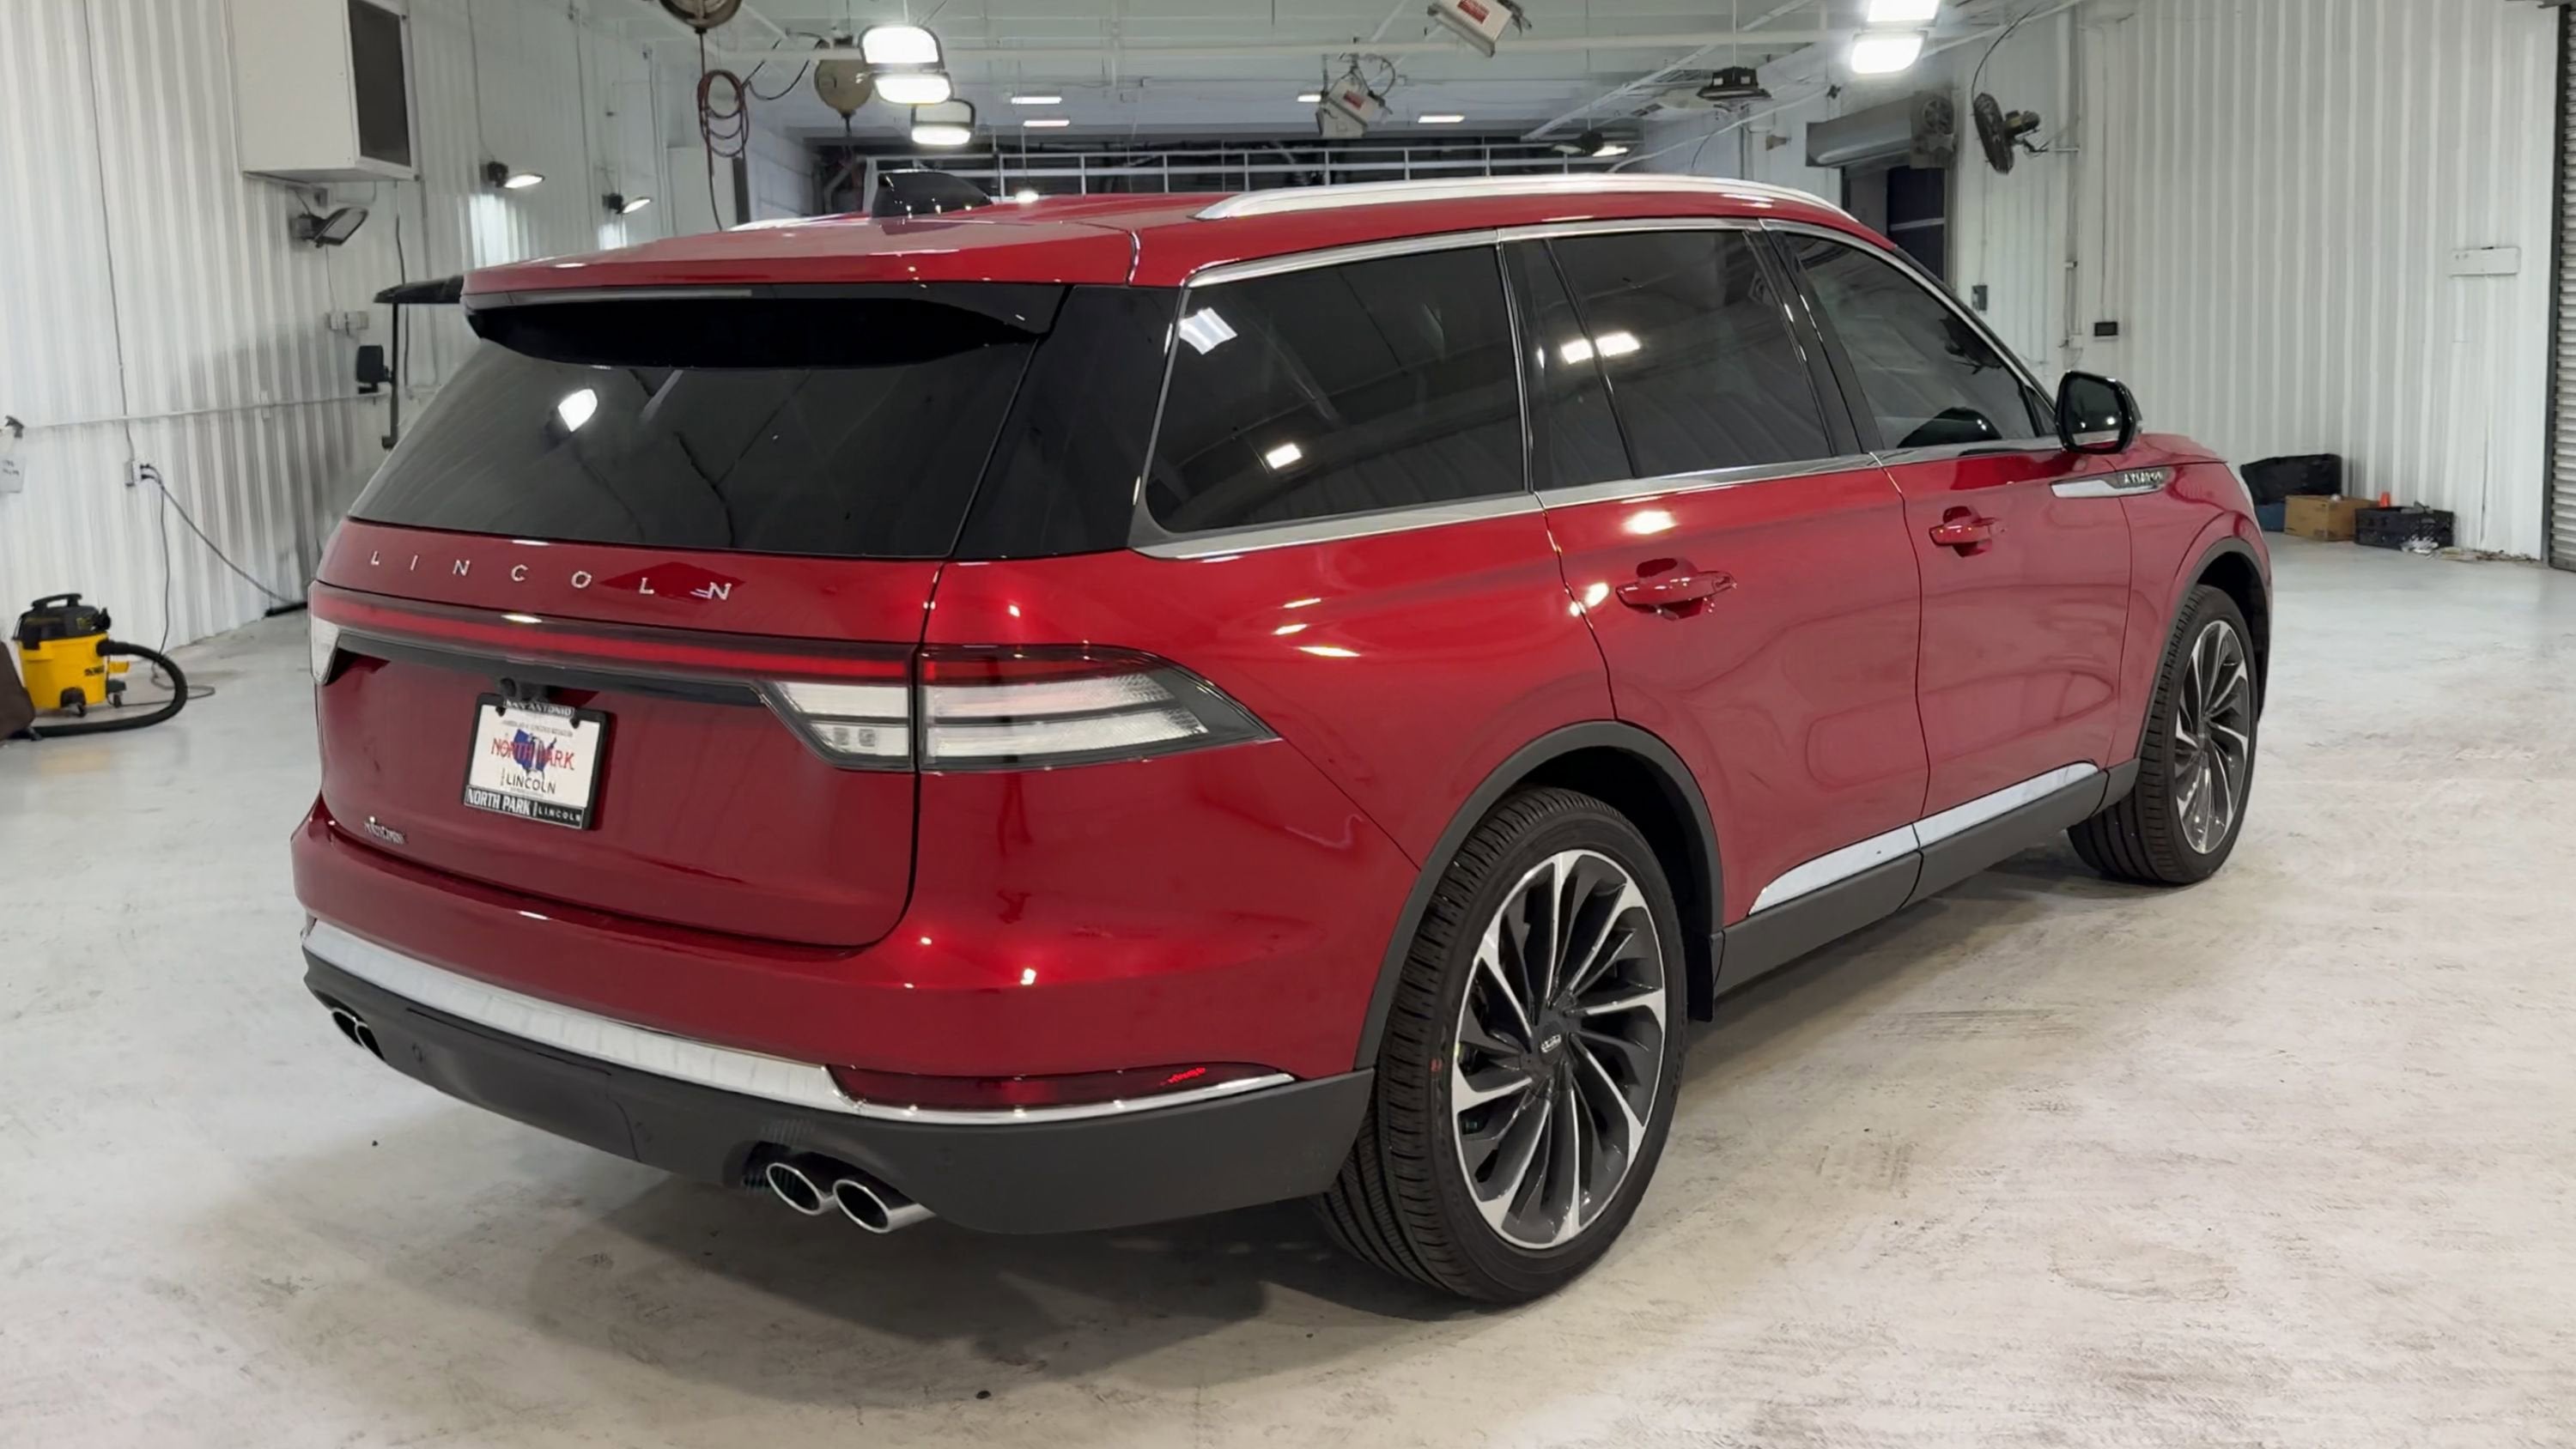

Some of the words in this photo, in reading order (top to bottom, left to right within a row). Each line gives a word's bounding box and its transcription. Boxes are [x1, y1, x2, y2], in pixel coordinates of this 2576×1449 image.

[370, 550, 732, 600] LINCOLN
[506, 773, 556, 794] LINCOLN
[466, 788, 501, 809] NORTH
[501, 795, 531, 816] PARK
[538, 807, 581, 822] LINCOLN
